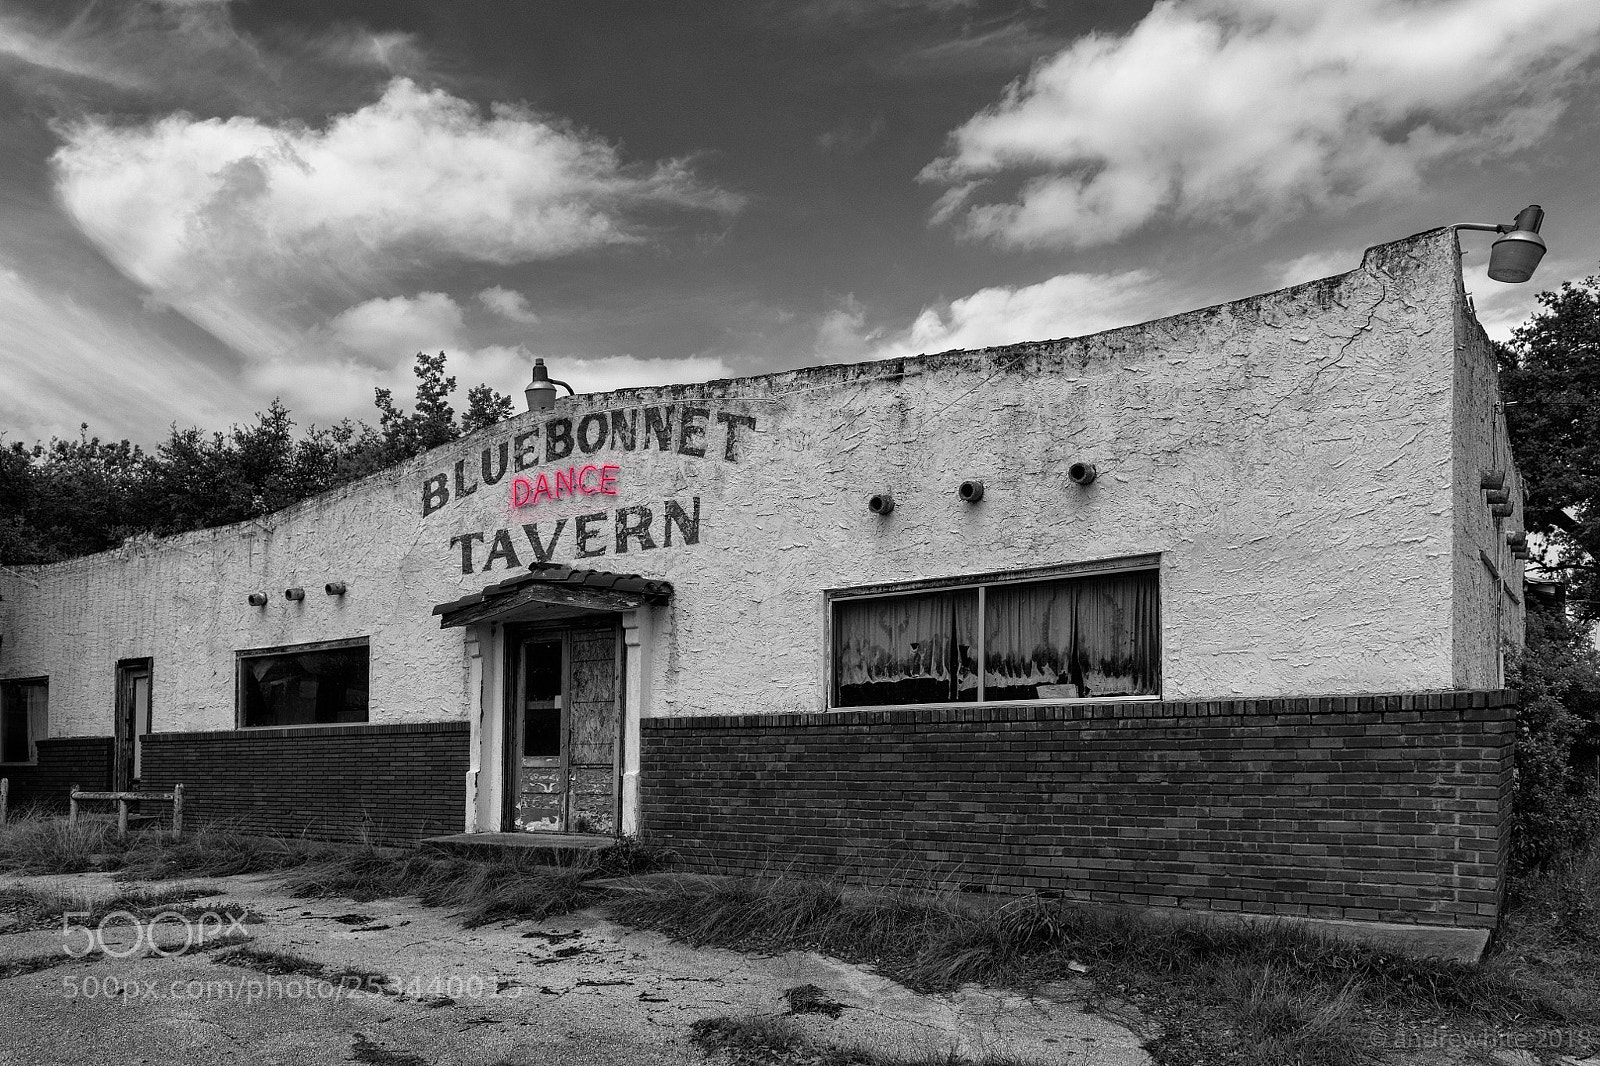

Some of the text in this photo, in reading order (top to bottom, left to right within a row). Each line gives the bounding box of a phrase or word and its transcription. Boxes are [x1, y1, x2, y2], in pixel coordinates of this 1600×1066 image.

[422, 404, 757, 519] BLUEBONNET
[513, 465, 620, 507] DANCE
[450, 496, 701, 575] TAVERN
